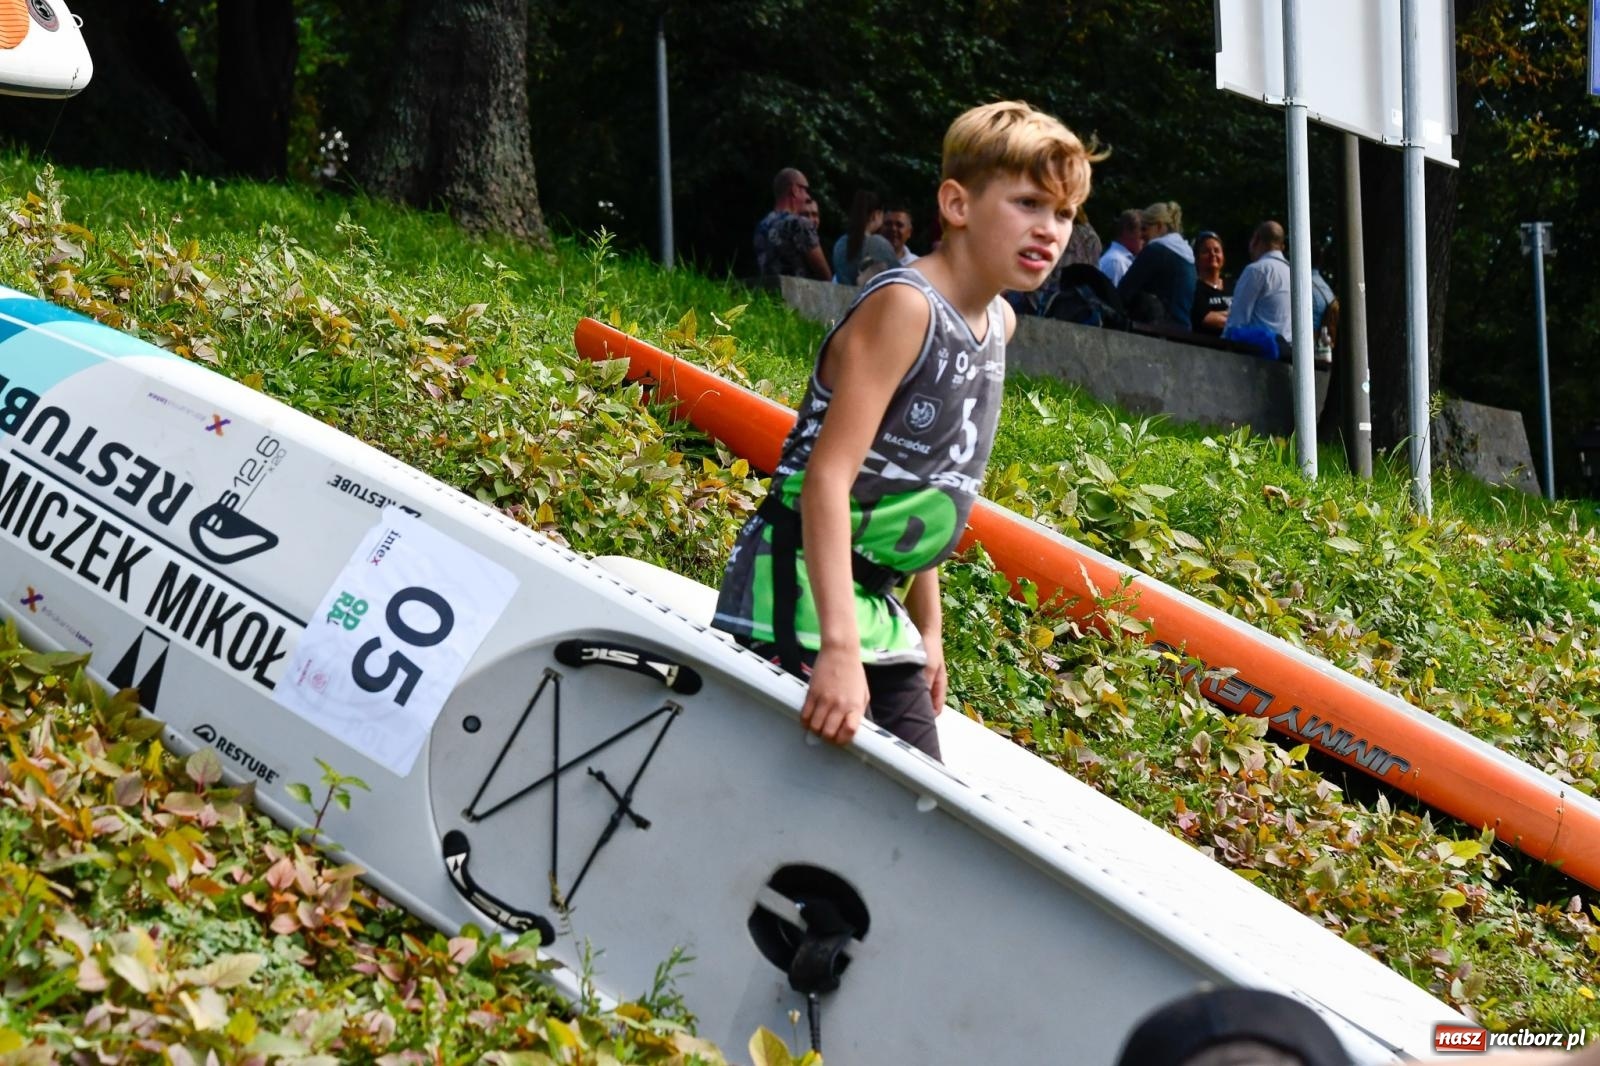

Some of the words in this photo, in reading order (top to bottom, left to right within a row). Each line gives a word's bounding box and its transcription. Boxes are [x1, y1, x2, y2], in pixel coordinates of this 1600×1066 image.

[0, 374, 194, 526] RESTUB
[949, 398, 978, 464] 5
[330, 474, 397, 509] ESTUBE
[370, 529, 401, 566] intex
[352, 586, 454, 707] 05
[215, 736, 277, 784] RESTUBE
[1270, 706, 1411, 775] JIMMY
